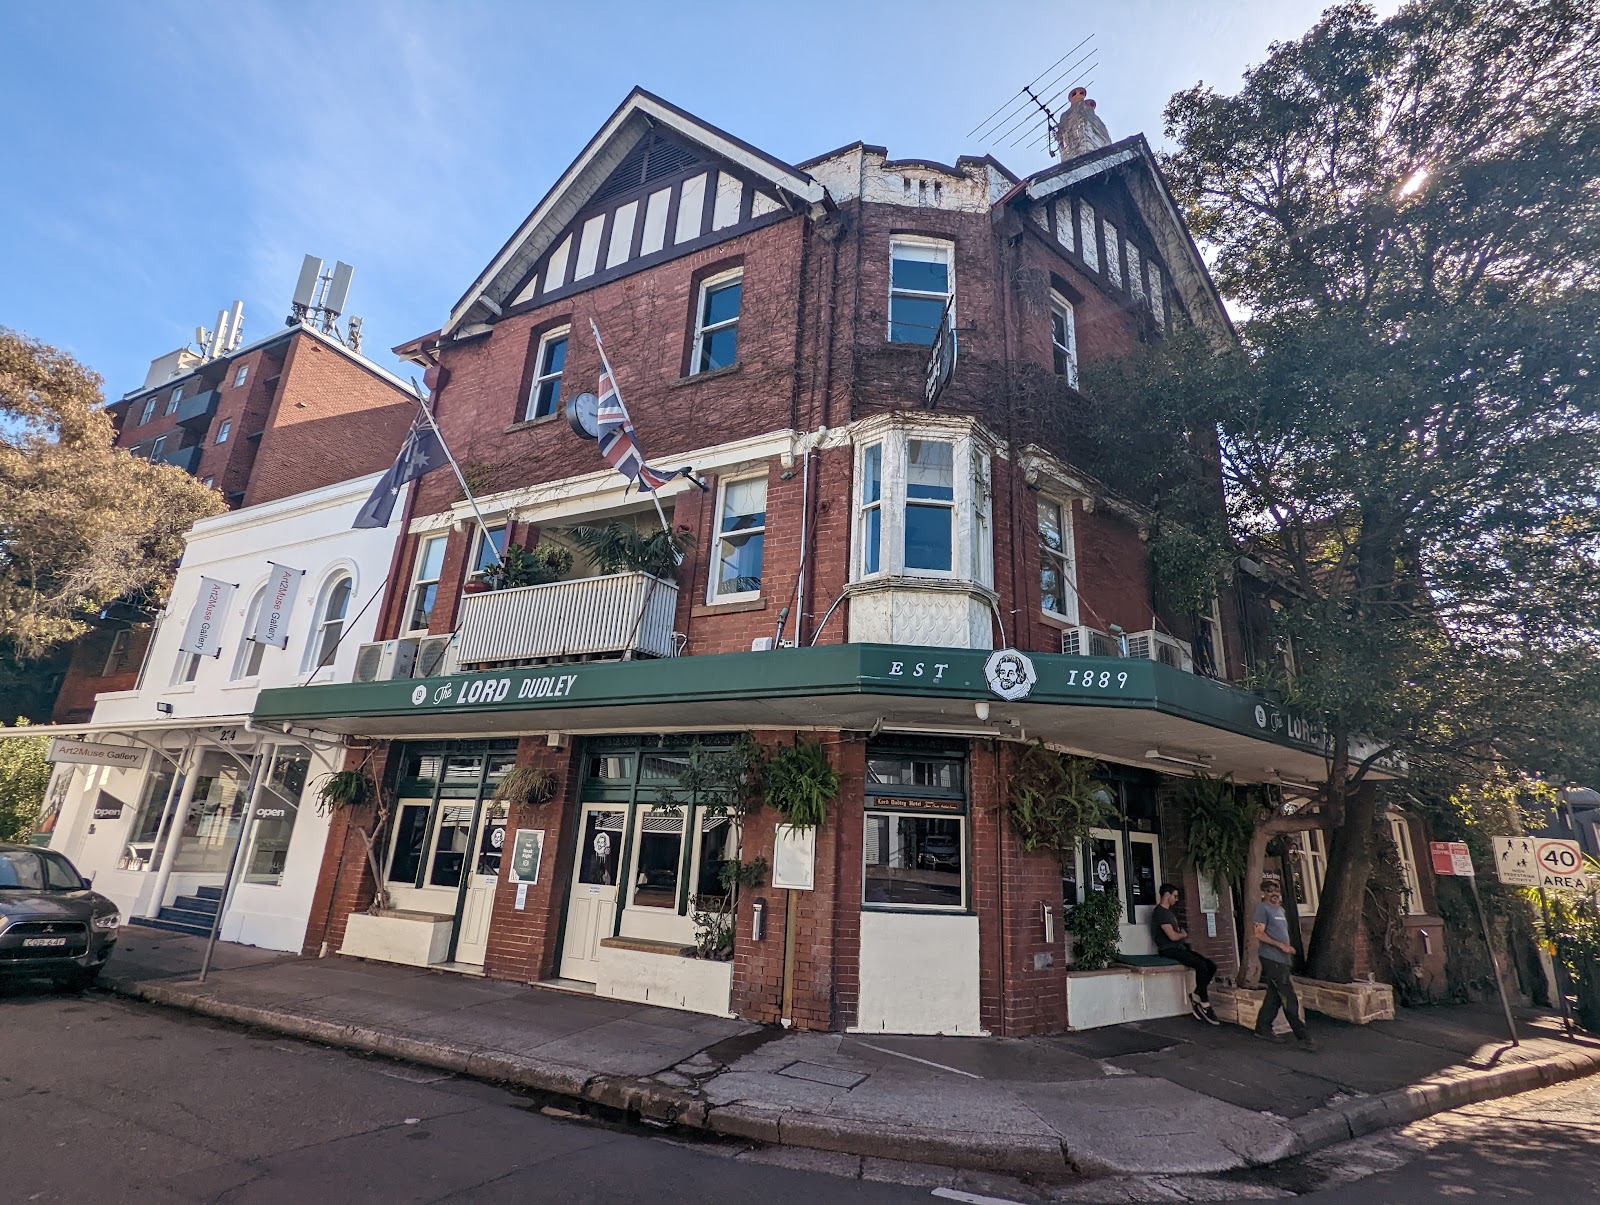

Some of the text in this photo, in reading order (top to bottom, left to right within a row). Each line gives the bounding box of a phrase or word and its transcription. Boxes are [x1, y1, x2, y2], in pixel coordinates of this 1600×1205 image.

[266, 571, 291, 641] Art2Muse Gallery
[195, 584, 221, 651] Art2Muse Gallery
[1066, 670, 1128, 689] 1889
[433, 682, 452, 705] The
[456, 678, 511, 704] LORD
[518, 675, 577, 699] DUDLEY
[59, 746, 138, 762] Art2Muse Gallery
[94, 808, 120, 816] open
[256, 808, 285, 817] open
[1544, 850, 1575, 867] 40
[1544, 876, 1586, 888] AREA
